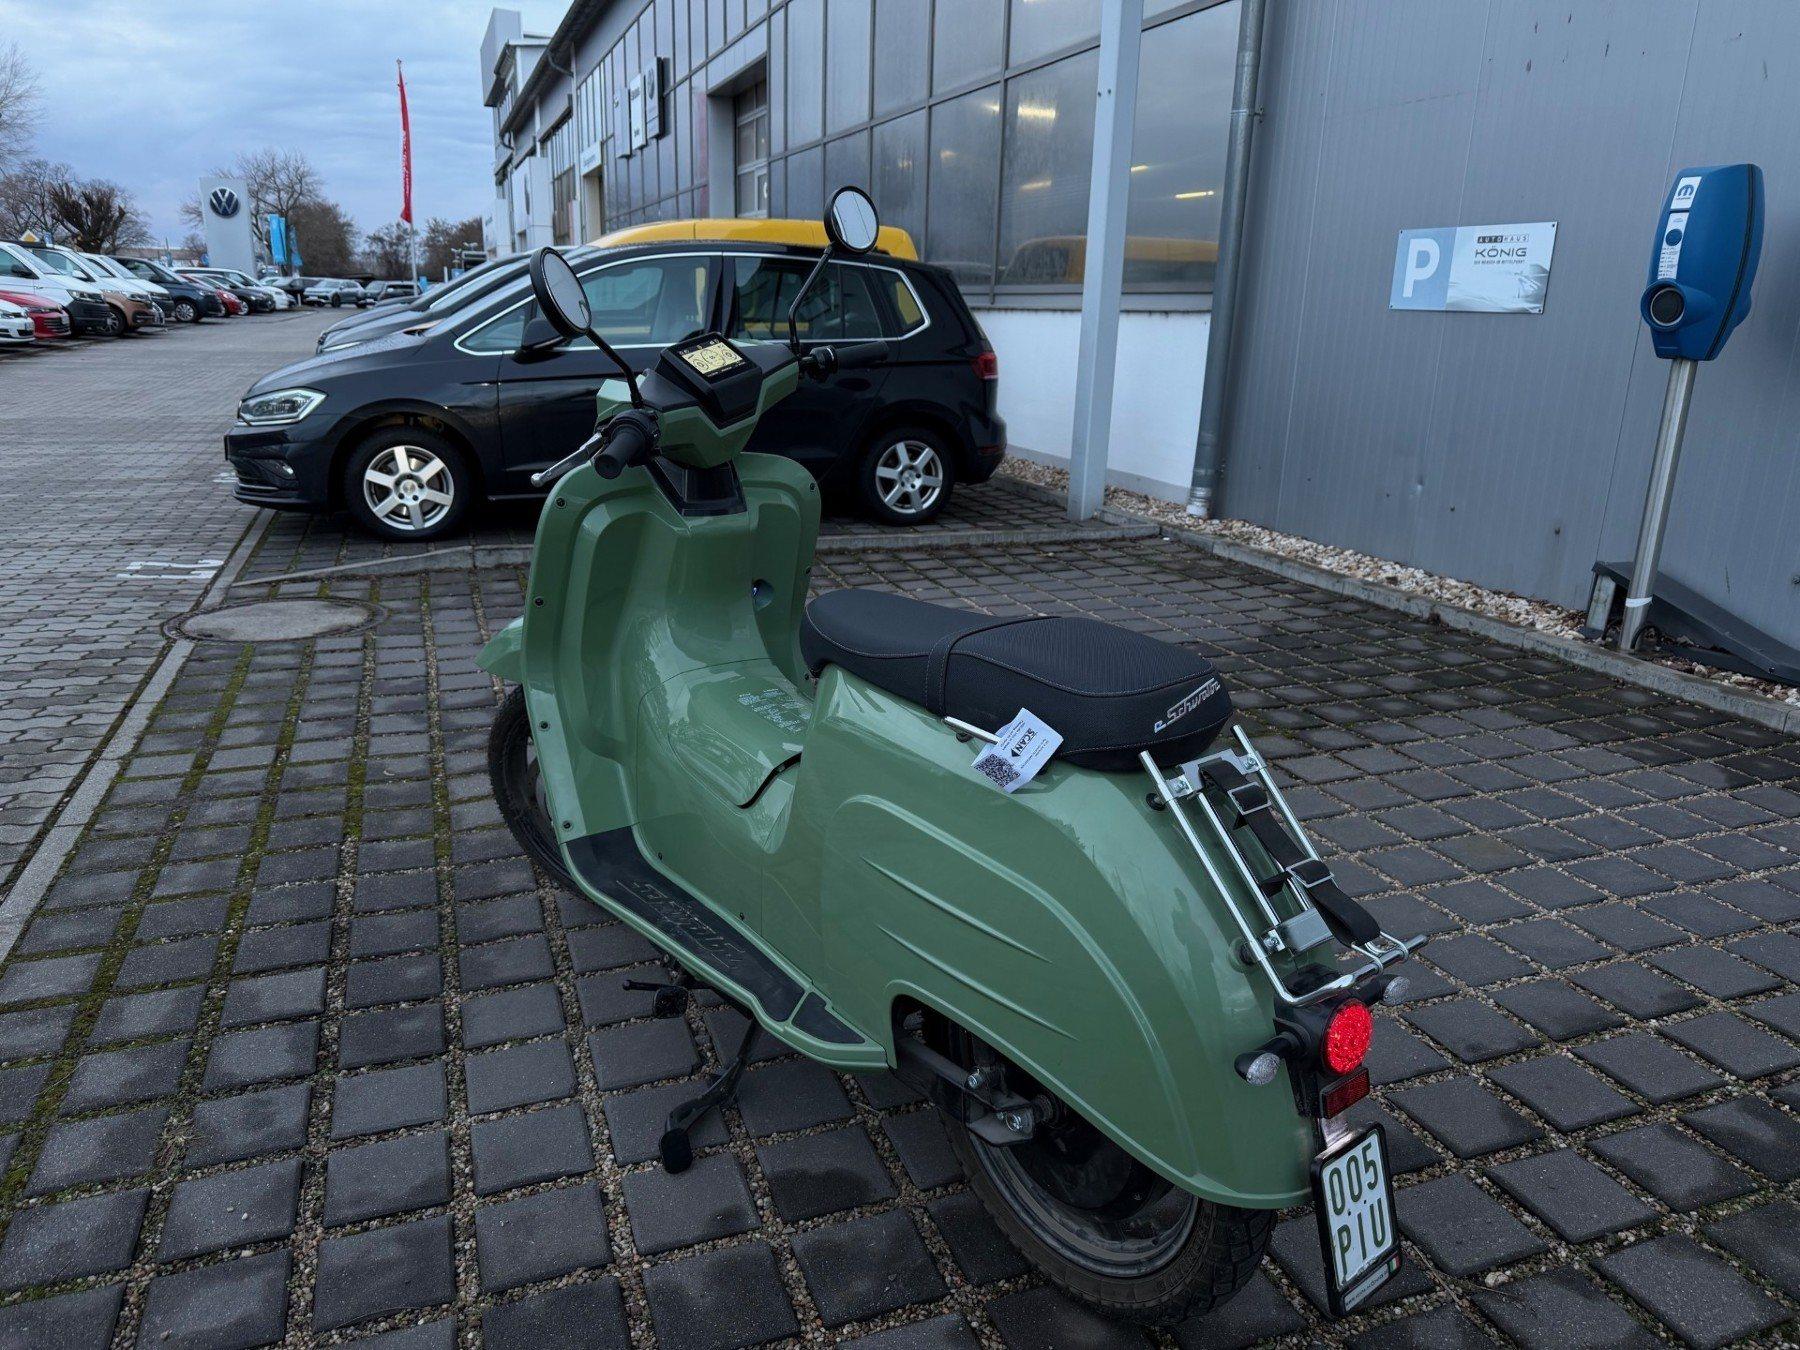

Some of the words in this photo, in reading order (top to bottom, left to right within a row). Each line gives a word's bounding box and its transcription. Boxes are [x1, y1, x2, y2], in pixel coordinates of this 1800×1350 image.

[1402, 237, 1441, 298] P
[1474, 245, 1527, 258] KÖNIG
[1017, 727, 1038, 754] SCAN
[1328, 1141, 1378, 1216] 005
[1337, 1198, 1386, 1280] PIU
